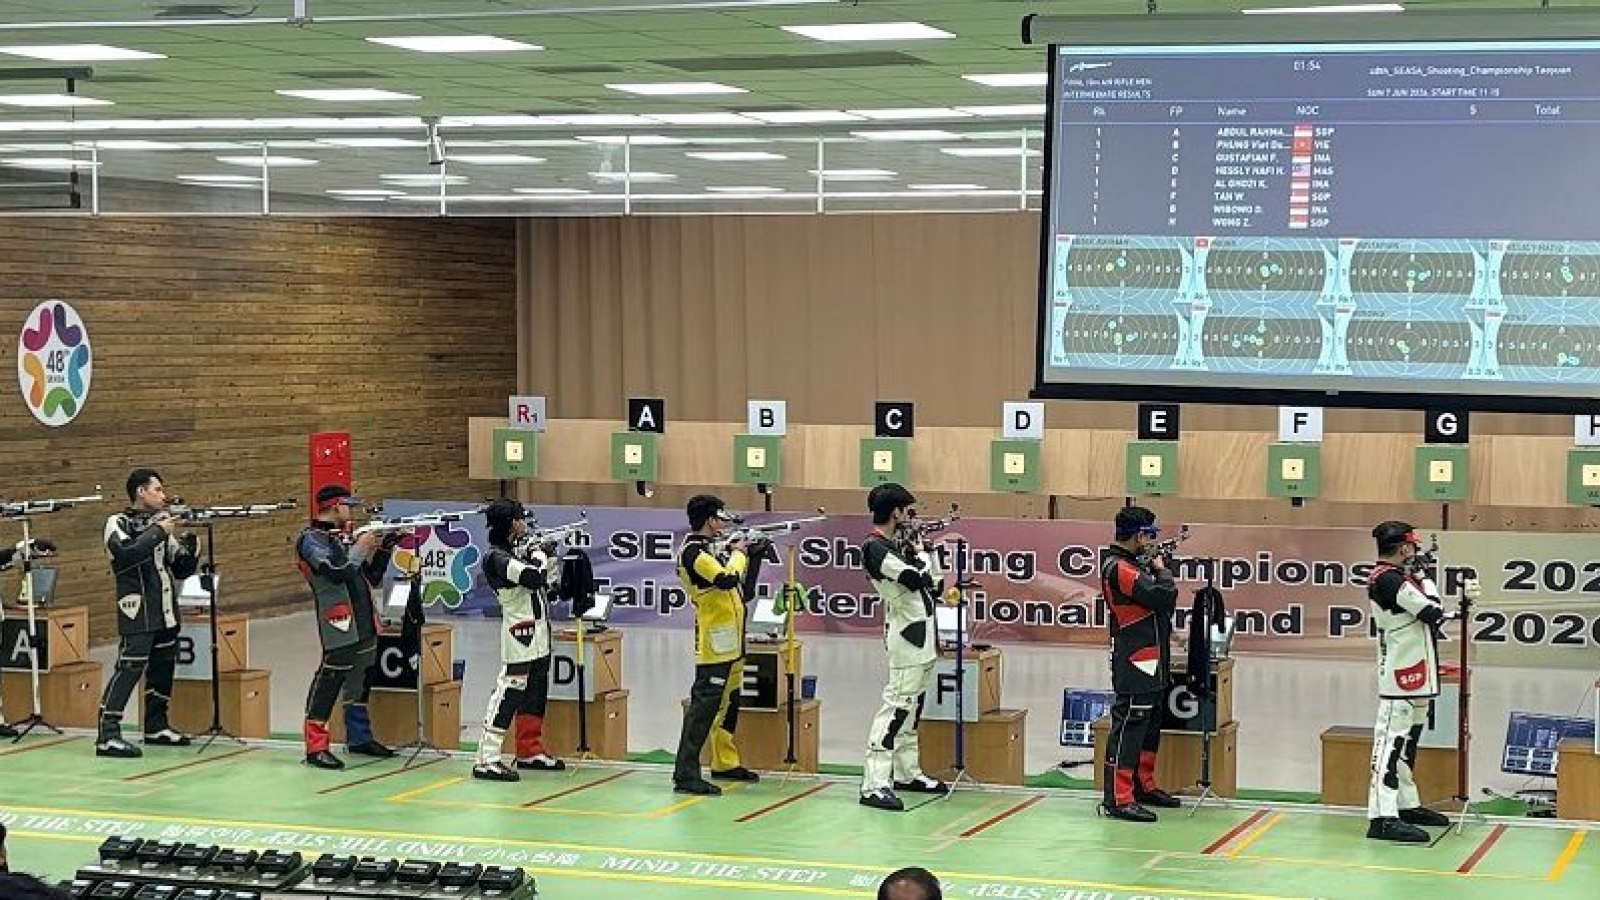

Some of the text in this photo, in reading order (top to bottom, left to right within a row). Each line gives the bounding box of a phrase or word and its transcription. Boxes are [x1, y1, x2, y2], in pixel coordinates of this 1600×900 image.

[1169, 106, 1183, 117] FP
[1217, 106, 1247, 116] Name
[1534, 104, 1562, 115] Total
[639, 404, 657, 428] A
[759, 408, 775, 428] B
[885, 408, 903, 430] C
[1015, 410, 1031, 430] D
[1150, 410, 1167, 432] E
[1293, 412, 1309, 434] F
[1436, 412, 1459, 436] G
[1473, 612, 1600, 645] 202
[10, 628, 37, 662] A
[176, 636, 196, 665] B
[380, 646, 403, 679] C
[553, 654, 577, 686] D
[738, 665, 760, 697] E
[936, 673, 959, 705] F
[1167, 684, 1201, 720] G
[599, 855, 682, 874] MIND
[688, 861, 749, 878] THE
[752, 866, 829, 884] STEP
